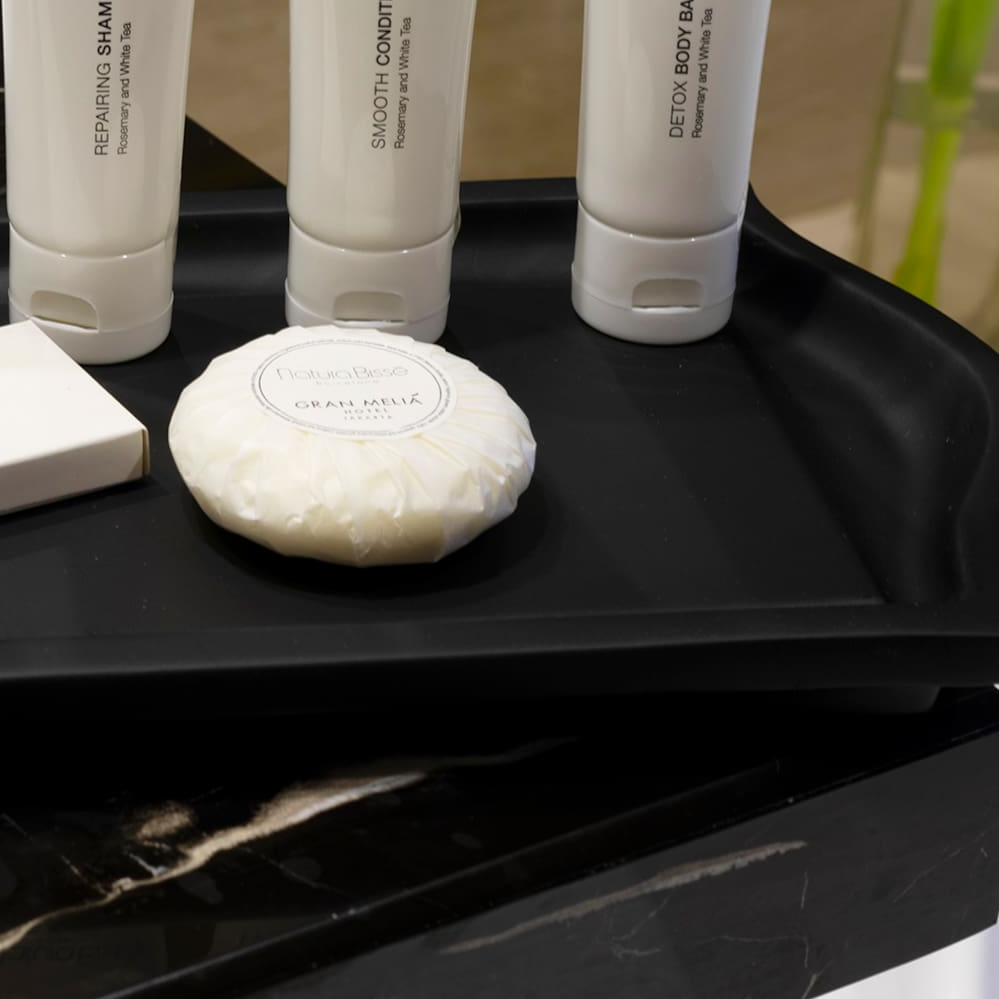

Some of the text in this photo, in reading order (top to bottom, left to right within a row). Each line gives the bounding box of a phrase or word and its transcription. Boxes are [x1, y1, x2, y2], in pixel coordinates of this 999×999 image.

[117, 22, 132, 155] Rosemary and White Tea
[394, 17, 412, 149] Rosemary and White Tea
[675, 26, 692, 75] BODY
[692, 8, 713, 138] Rosemary and White Tea
[94, 62, 111, 156] REPAIRING
[371, 72, 389, 149] SMOOTH
[669, 80, 687, 138] DETOX
[294, 392, 423, 409] GRAN MELIÁ
